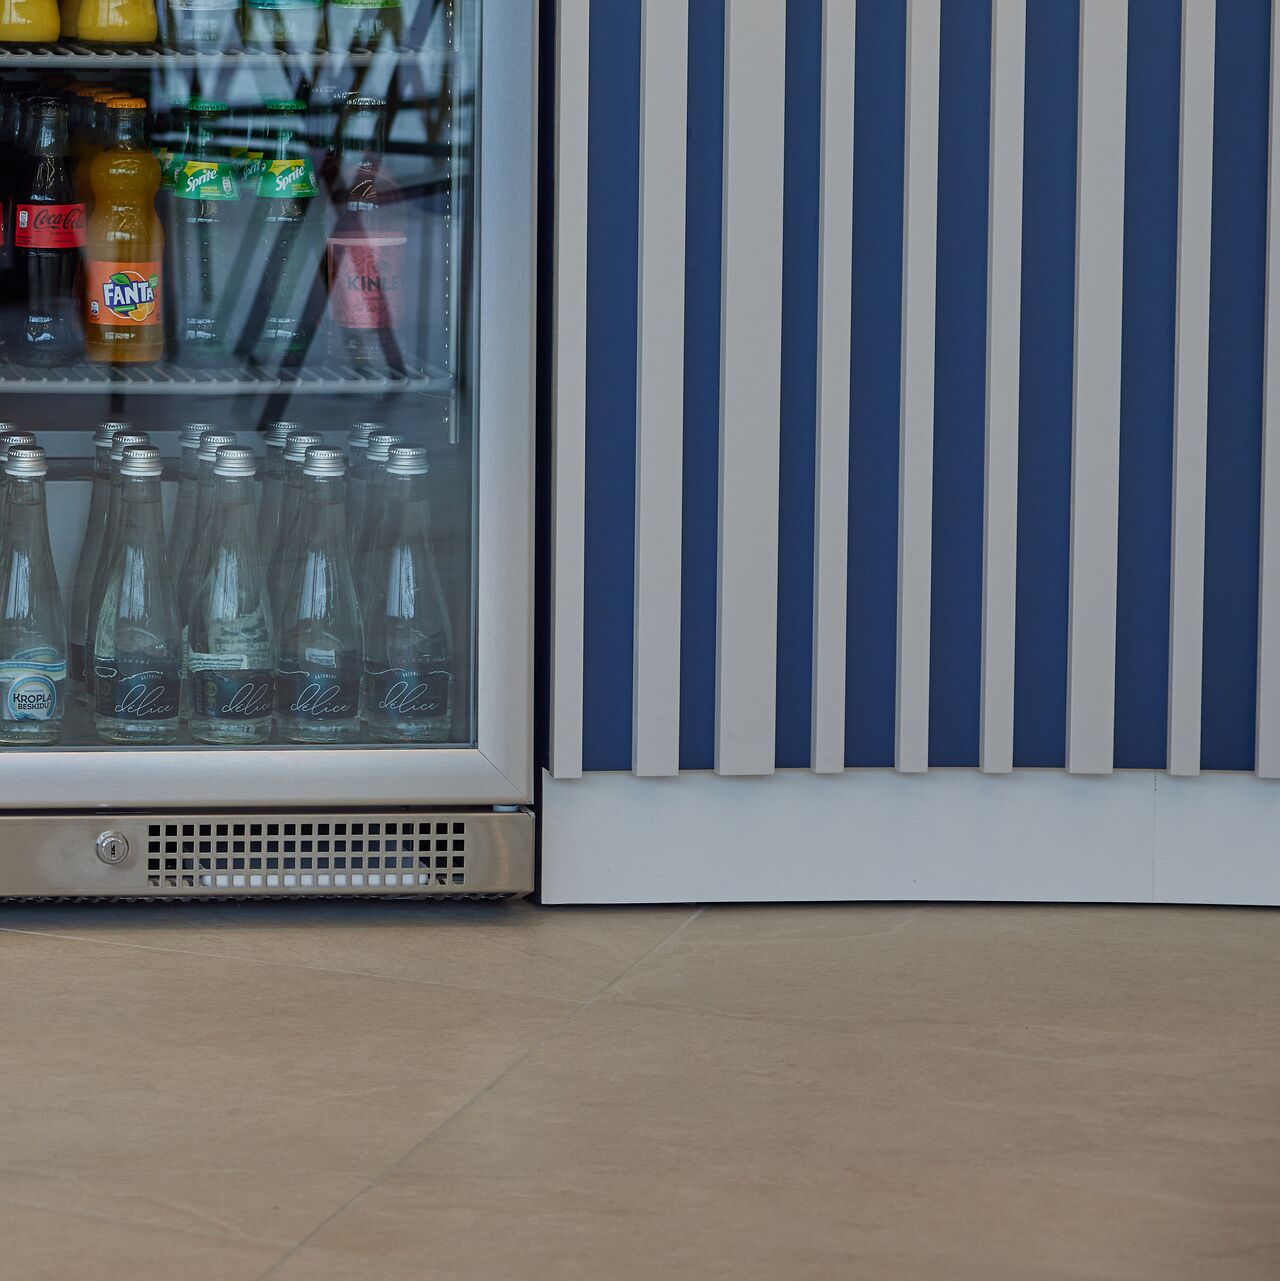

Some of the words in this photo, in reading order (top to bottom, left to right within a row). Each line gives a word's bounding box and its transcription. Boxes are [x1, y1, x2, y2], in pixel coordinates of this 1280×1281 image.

[185, 169, 218, 193] Sprite
[275, 166, 306, 192] Sprite
[347, 275, 401, 292] KINLE
[103, 282, 154, 306] FANTA
[13, 692, 53, 704] KROPLA
[17, 702, 49, 710] BESKIDU
